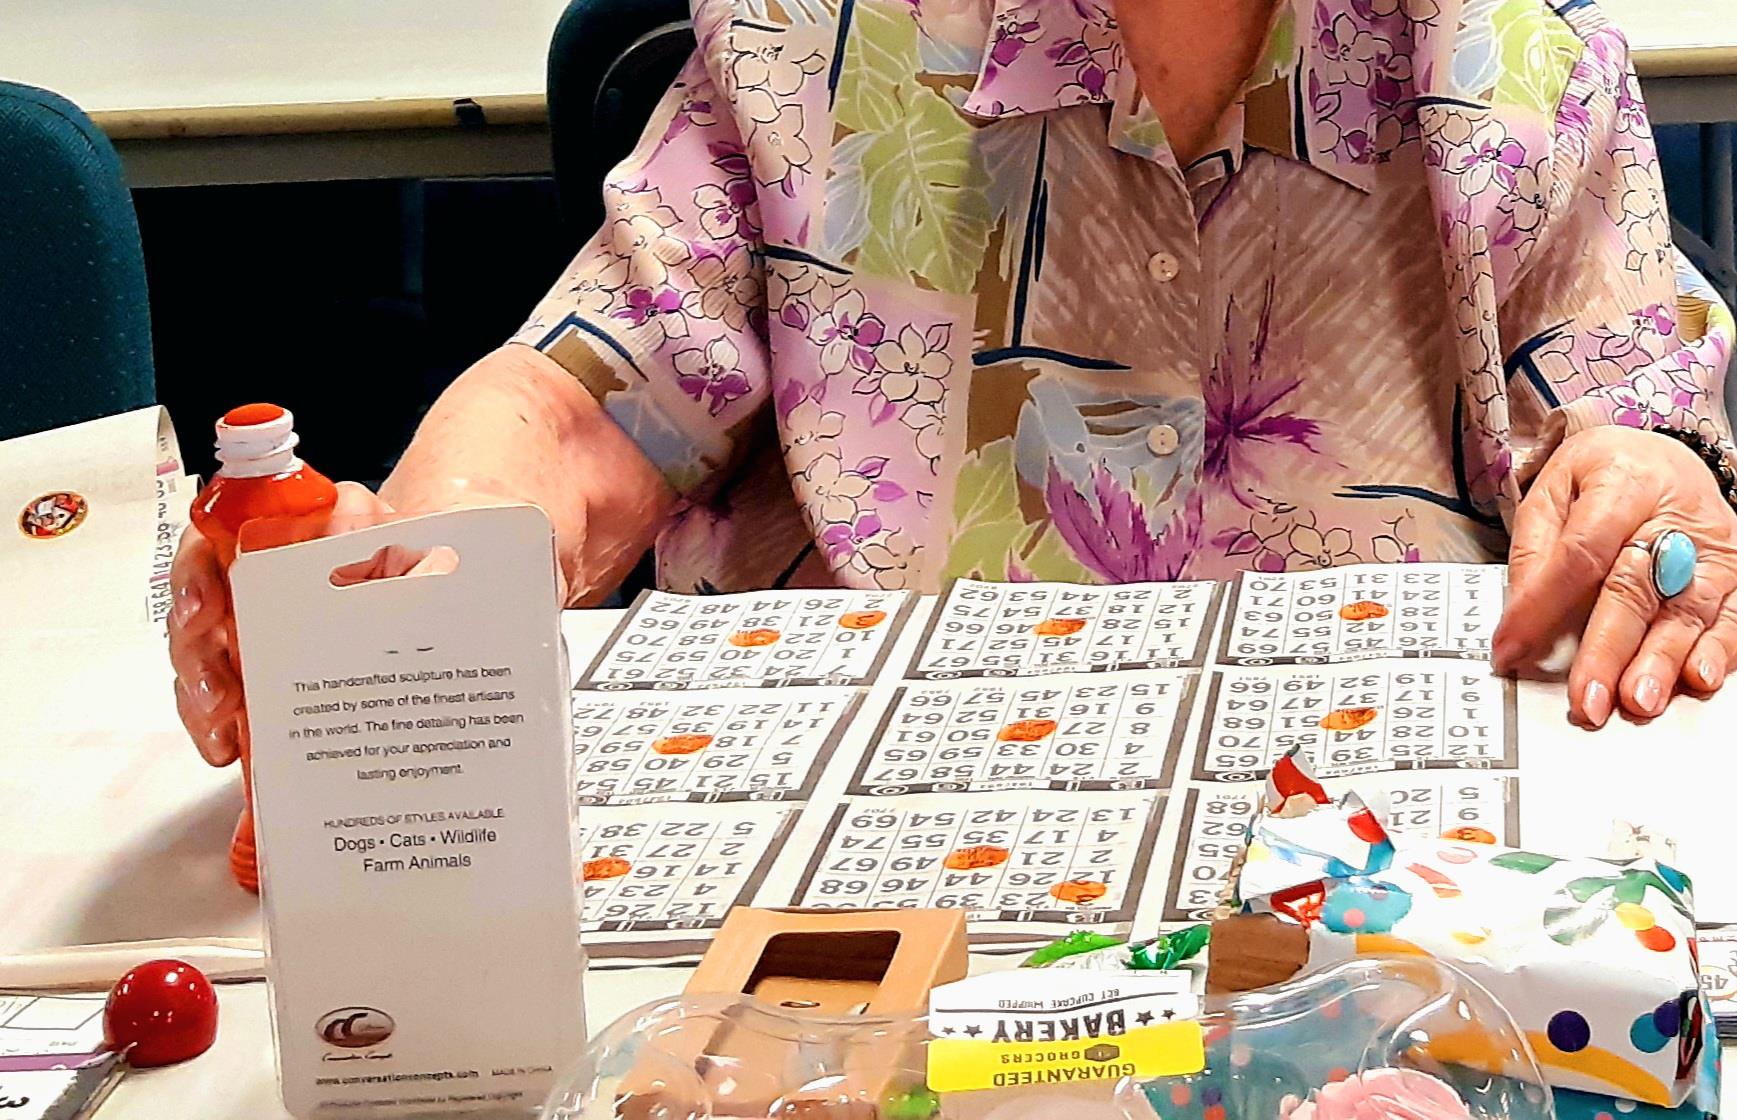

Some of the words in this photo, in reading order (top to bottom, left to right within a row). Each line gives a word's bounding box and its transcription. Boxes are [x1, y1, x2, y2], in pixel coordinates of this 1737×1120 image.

[455, 667, 478, 679] has
[1396, 673, 1434, 684] 19
[1284, 681, 1323, 692] 49
[1340, 675, 1380, 688] 32
[1462, 675, 1480, 686] 4
[1075, 685, 1118, 698] 23
[1130, 683, 1170, 695] 15
[1230, 682, 1270, 693] 66
[910, 695, 952, 706] 66
[963, 693, 1005, 704] 57
[1020, 690, 1062, 701] 45
[1338, 694, 1378, 705] 37
[1395, 690, 1434, 701] 17
[1461, 691, 1480, 702] 9
[343, 701, 357, 713] by
[361, 698, 393, 710] some
[397, 695, 409, 706] of
[412, 694, 431, 705] the
[1071, 704, 1110, 715] 16
[1135, 703, 1155, 715] 9
[1226, 700, 1268, 712] 64
[1281, 698, 1322, 710] 47
[902, 713, 944, 724] 64
[954, 710, 998, 723] 52
[1018, 707, 1054, 718] 31
[303, 726, 323, 738] the
[365, 720, 388, 732] The
[469, 714, 491, 726] has
[364, 745, 380, 756] for
[383, 744, 410, 757] your
[587, 759, 632, 772] 58
[644, 759, 688, 770] 40
[704, 754, 749, 768] 29
[771, 752, 792, 766] 5
[1091, 808, 1135, 821] 13
[1207, 802, 1250, 815] 68
[851, 815, 897, 828] 69
[910, 813, 956, 828] 54
[972, 810, 1017, 827] 42
[1033, 809, 1079, 823] 24
[600, 824, 648, 839] 38
[664, 823, 709, 837] 22
[733, 821, 757, 836] 5
[334, 836, 376, 853] Dogs
[390, 833, 426, 848] Cats
[440, 828, 497, 844] Wildlife
[842, 836, 886, 849] 74
[901, 834, 946, 849] 55
[963, 831, 1009, 845] 35
[1023, 830, 1069, 844] 17
[1098, 829, 1118, 843] 4
[364, 858, 404, 872] Farm
[409, 853, 472, 870] Animals
[1022, 852, 1064, 865] 21
[1090, 849, 1112, 863] 2
[695, 863, 741, 875] 14
[830, 858, 878, 871] 67
[891, 857, 937, 871] 49
[634, 865, 681, 878] 16
[619, 884, 669, 897] 23
[693, 884, 717, 895] 4
[1701, 974, 1729, 990] 45
[991, 1009, 1126, 1043] BAKERY
[1001, 1050, 1080, 1064] GROCERS
[993, 1063, 1135, 1087] GUARANTEED
